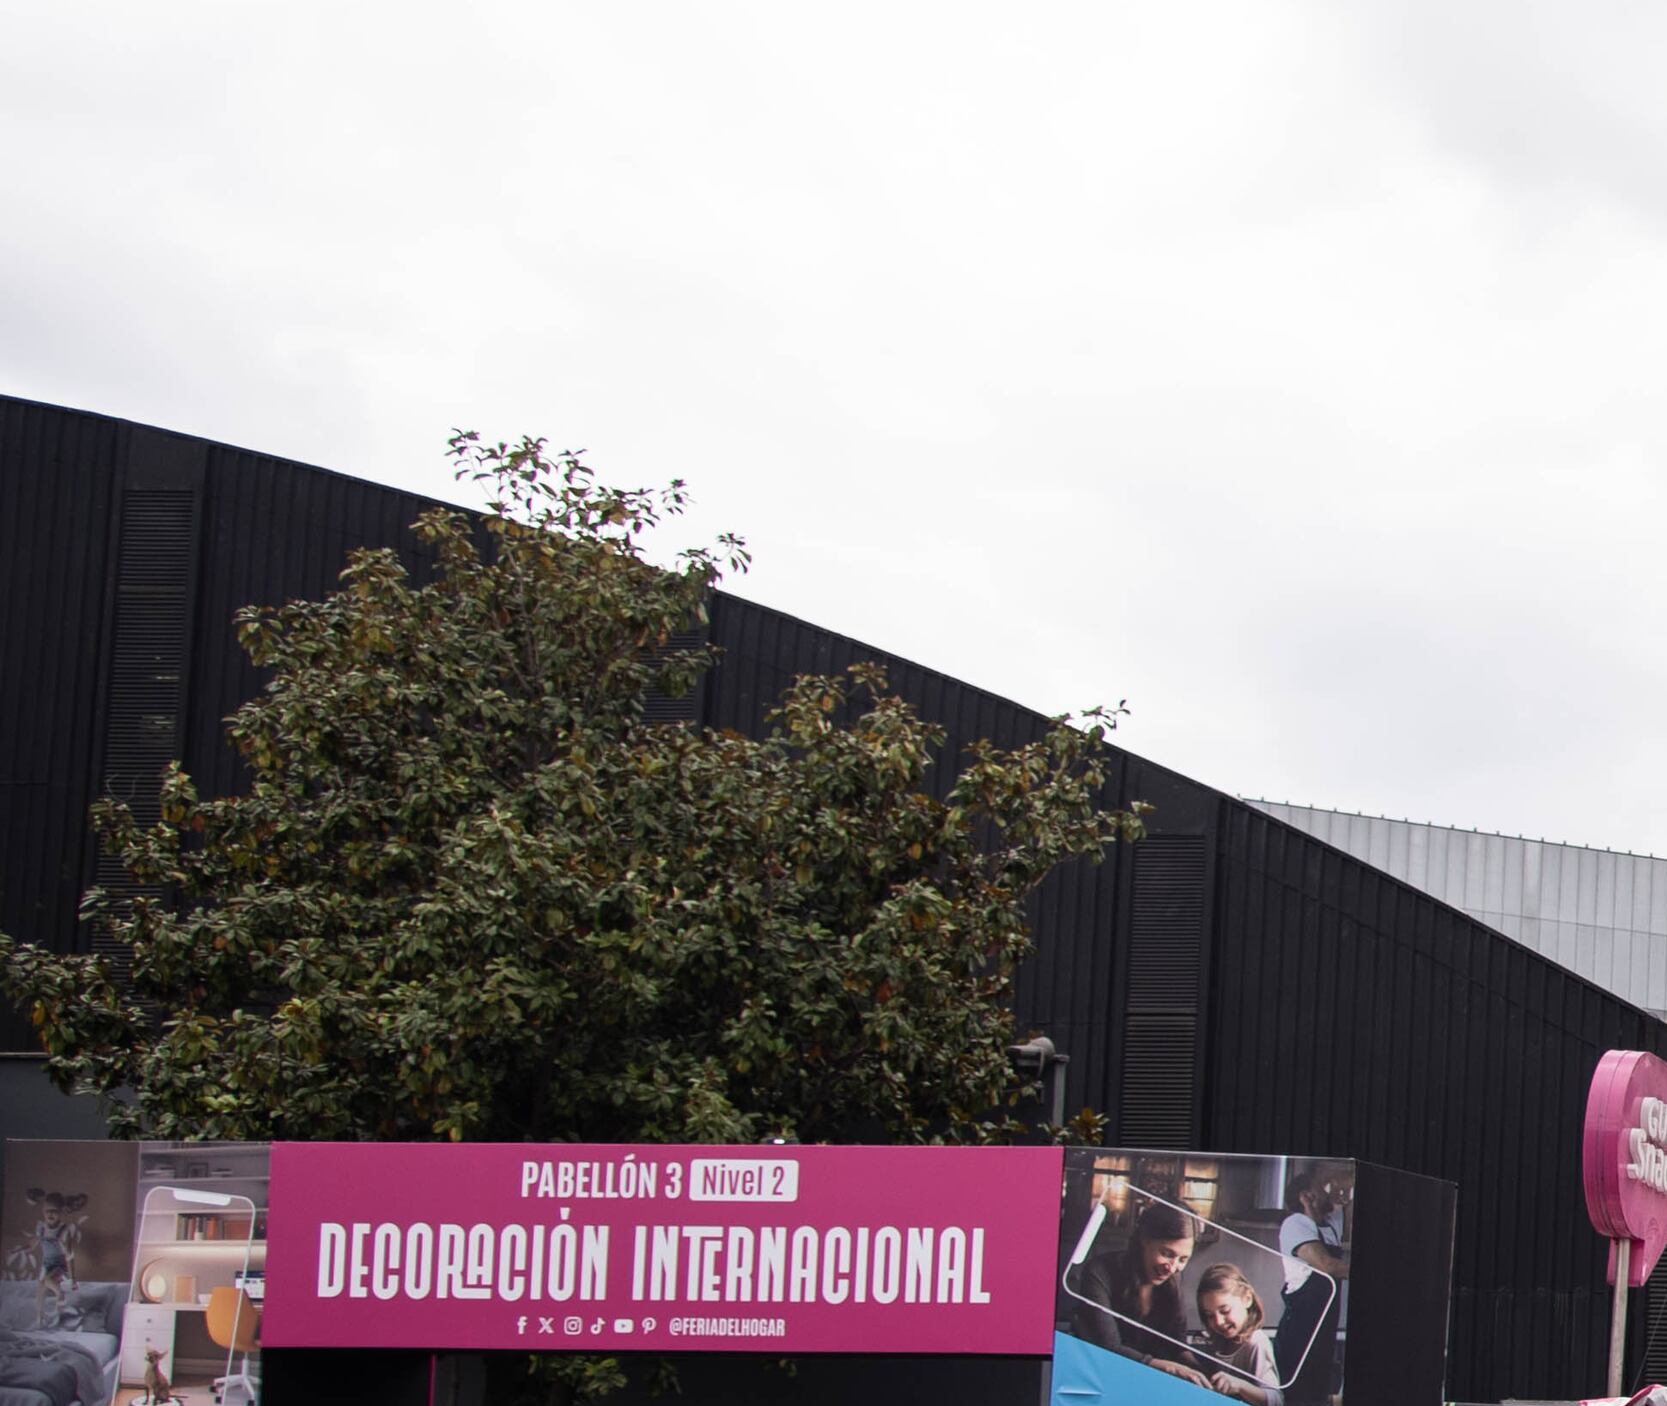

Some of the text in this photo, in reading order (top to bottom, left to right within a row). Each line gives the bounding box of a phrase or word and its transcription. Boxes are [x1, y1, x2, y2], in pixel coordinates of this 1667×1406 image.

[521, 1153, 784, 1198] PABELLÓN 3 Nivel 2
[317, 1207, 991, 1304] DECORACIÓN INTERNACIONAL
[669, 1317, 785, 1337] @FERIADELHOGAR
